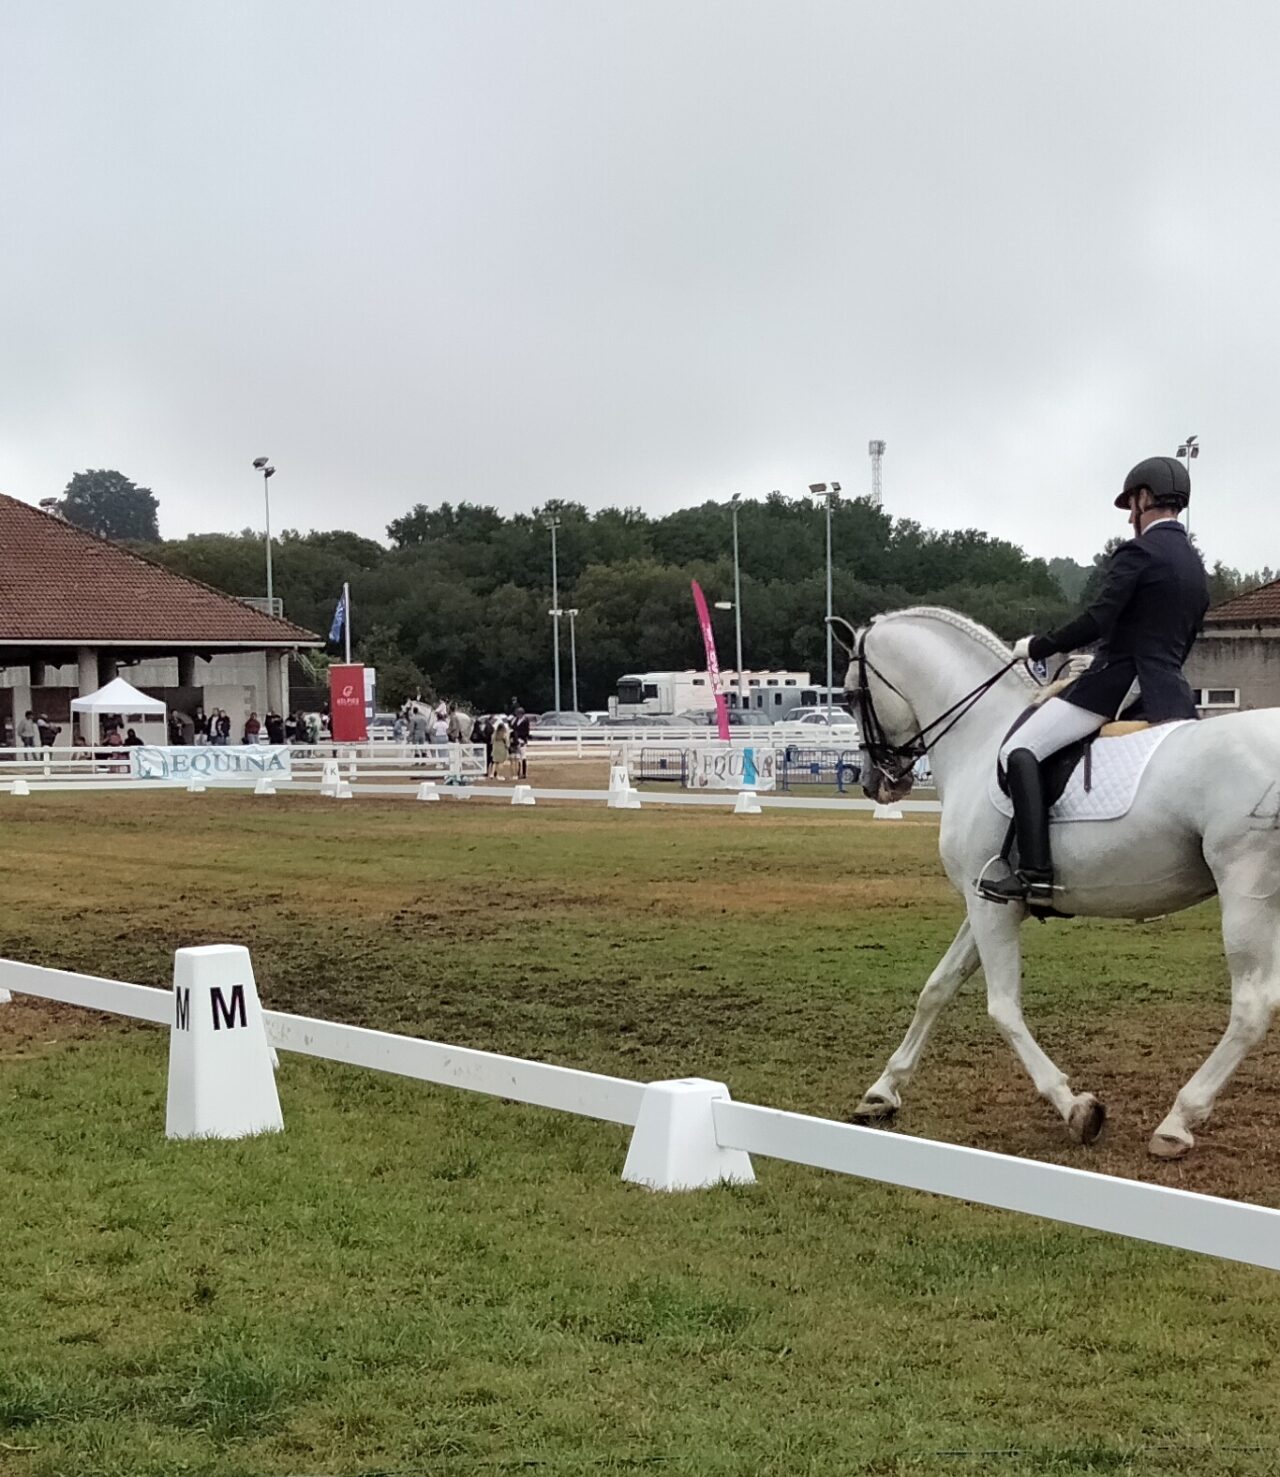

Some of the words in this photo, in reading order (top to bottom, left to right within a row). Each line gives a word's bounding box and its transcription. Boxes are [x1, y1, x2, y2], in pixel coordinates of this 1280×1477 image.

[170, 753, 285, 776] EQUINA
[330, 767, 337, 776] K
[619, 773, 626, 784] V
[176, 985, 190, 1032] M
[209, 984, 248, 1031] M
